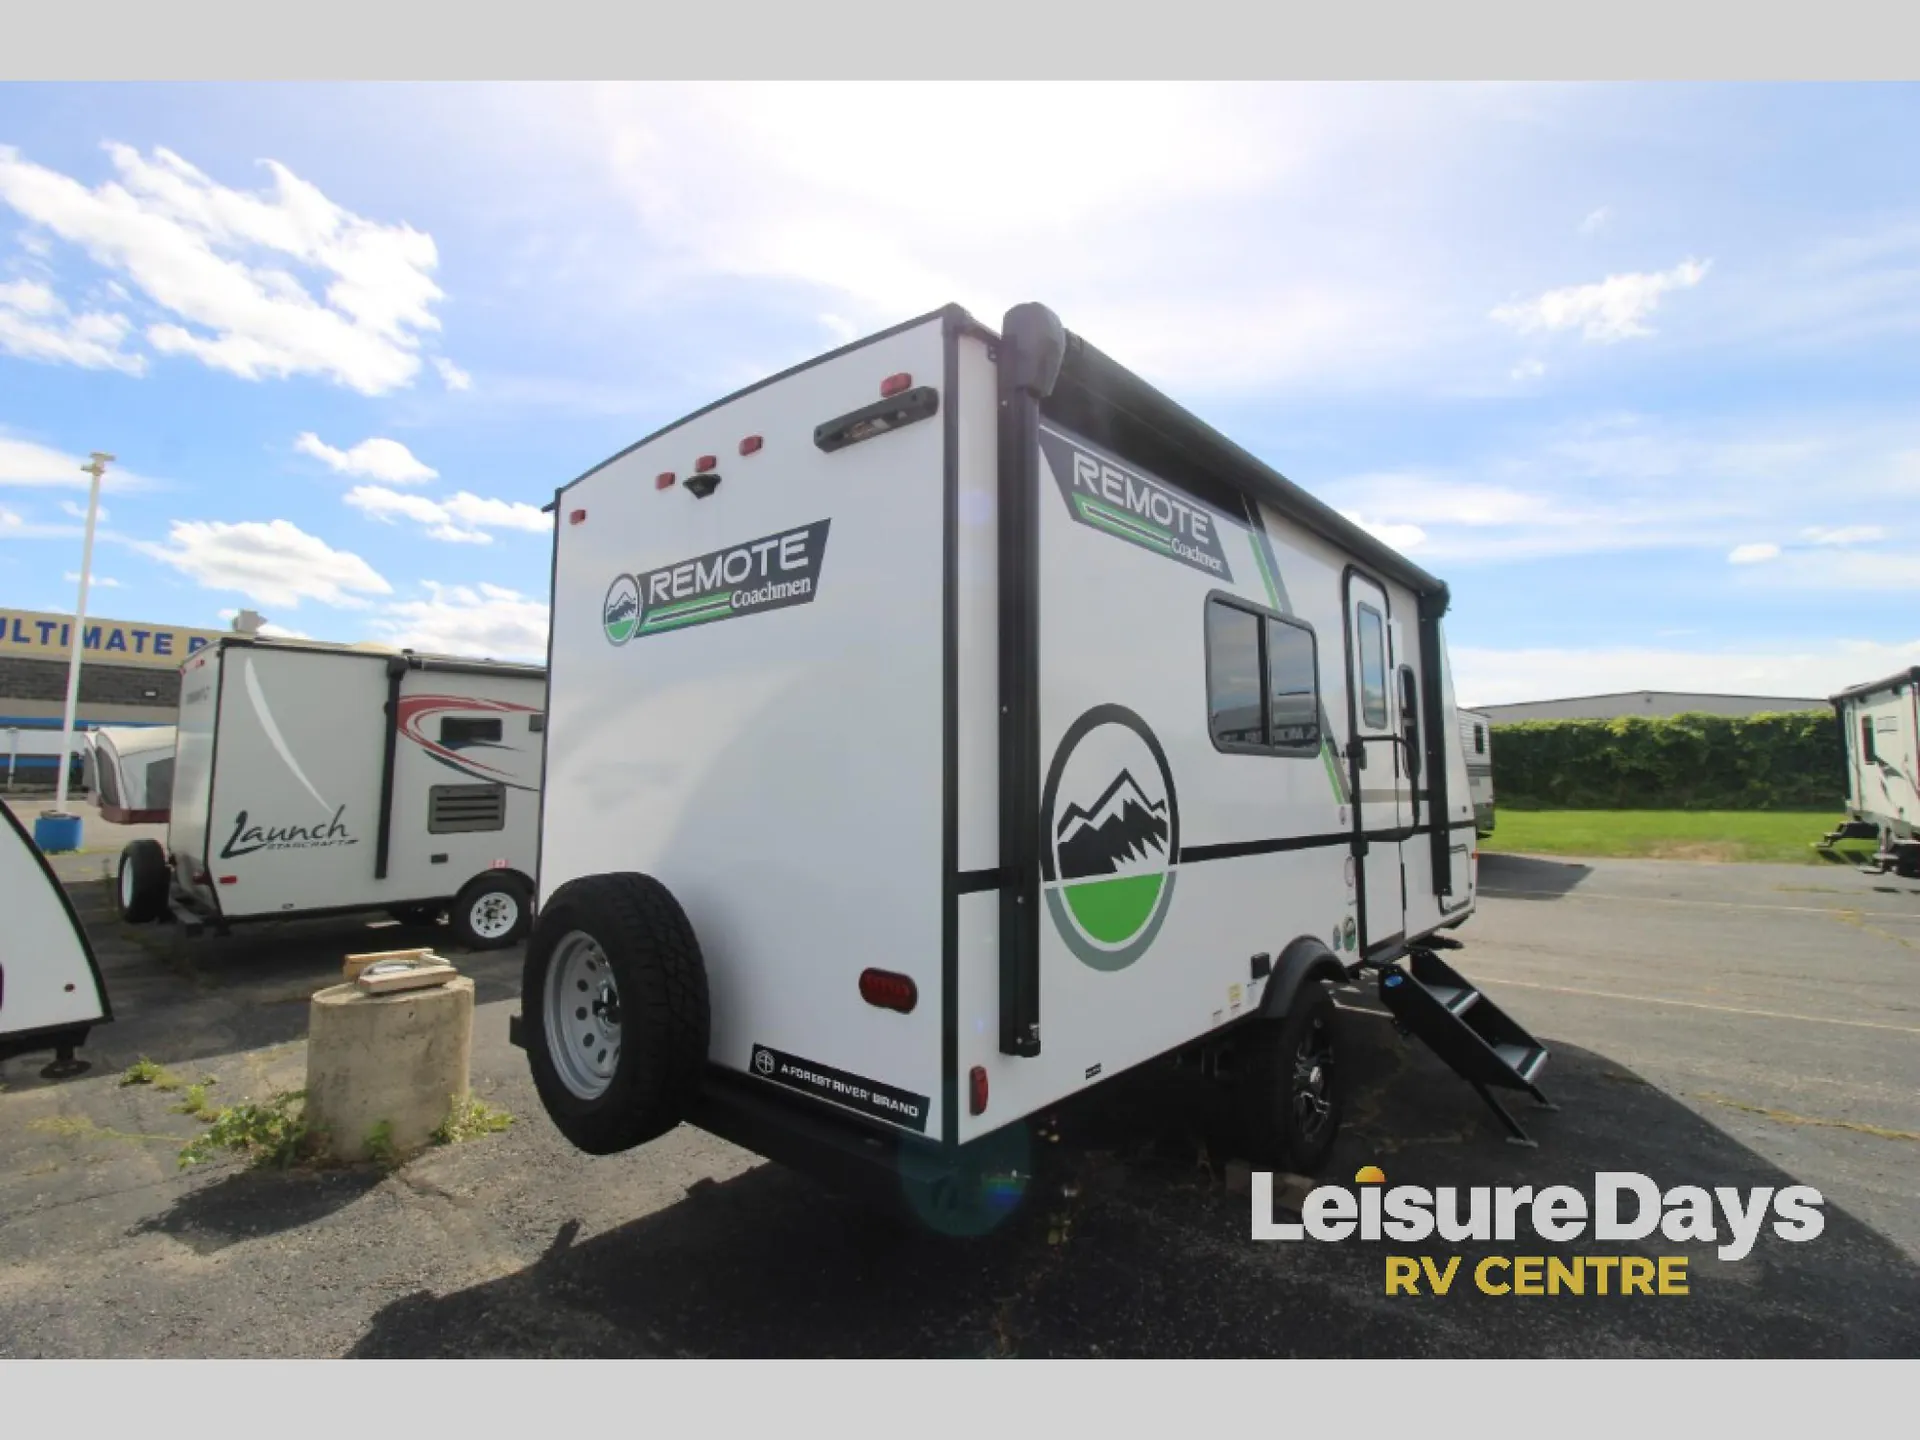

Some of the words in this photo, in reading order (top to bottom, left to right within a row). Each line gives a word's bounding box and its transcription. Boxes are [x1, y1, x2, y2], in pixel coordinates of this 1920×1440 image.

[1073, 451, 1210, 545] REMOTE
[649, 530, 809, 604] REMOTE
[731, 577, 811, 608] Coachmen
[220, 804, 348, 859] Launch
[780, 1063, 789, 1074] A
[790, 1066, 831, 1088] FOREST
[872, 1092, 919, 1117] BRAND
